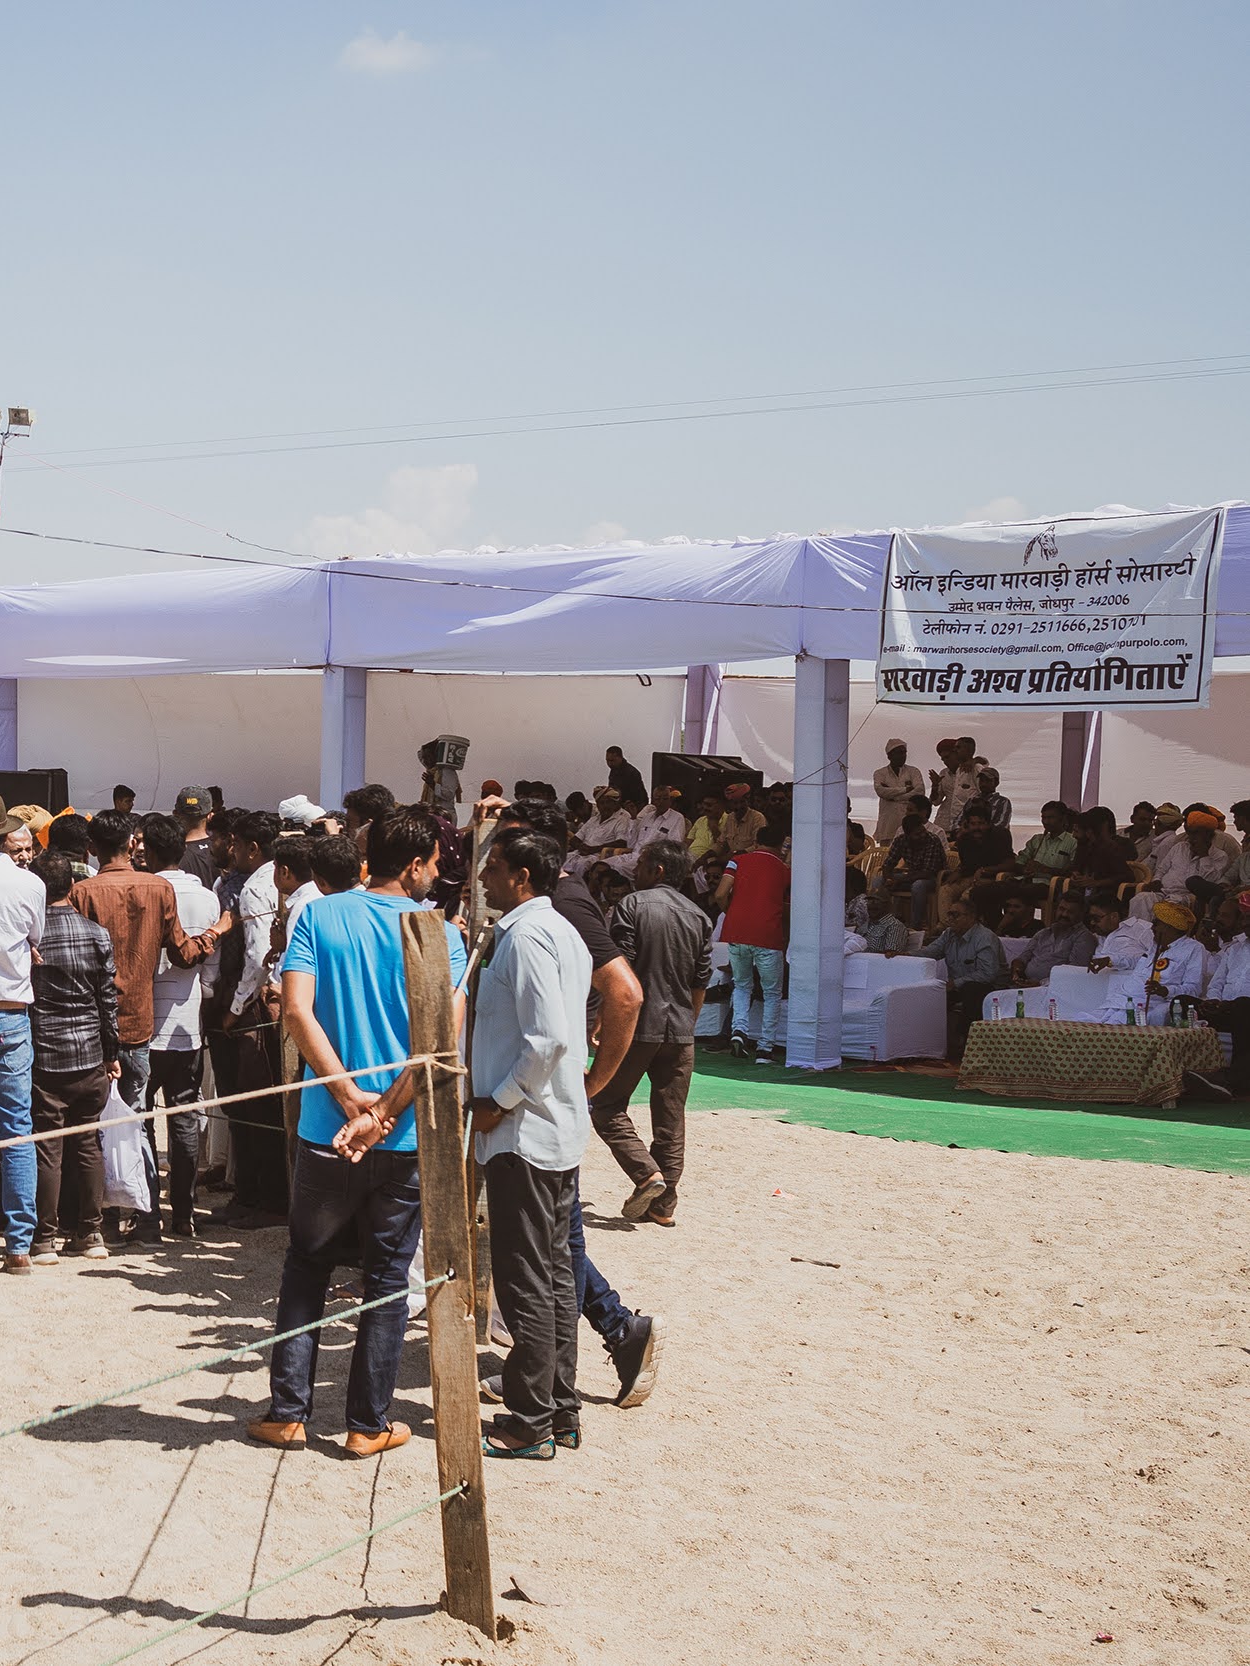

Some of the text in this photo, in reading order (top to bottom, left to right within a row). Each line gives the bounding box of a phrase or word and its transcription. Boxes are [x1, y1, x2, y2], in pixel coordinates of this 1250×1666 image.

[891, 569, 934, 592] ऑल
[936, 569, 998, 596] इन्डिया
[1000, 563, 1072, 592] मारवाड़ी
[1074, 558, 1112, 588] हॉर्स
[976, 601, 1003, 612] भवन
[1005, 598, 1036, 612] पैलेस,
[1039, 596, 1075, 612] जोधपुर
[1086, 593, 1130, 608] 342006
[922, 619, 972, 635] टेलीफोन
[883, 644, 905, 653] e-mail
[913, 643, 1064, 656] marwarihorsesociety@gmail.com,
[967, 669, 1027, 693] अश्व
